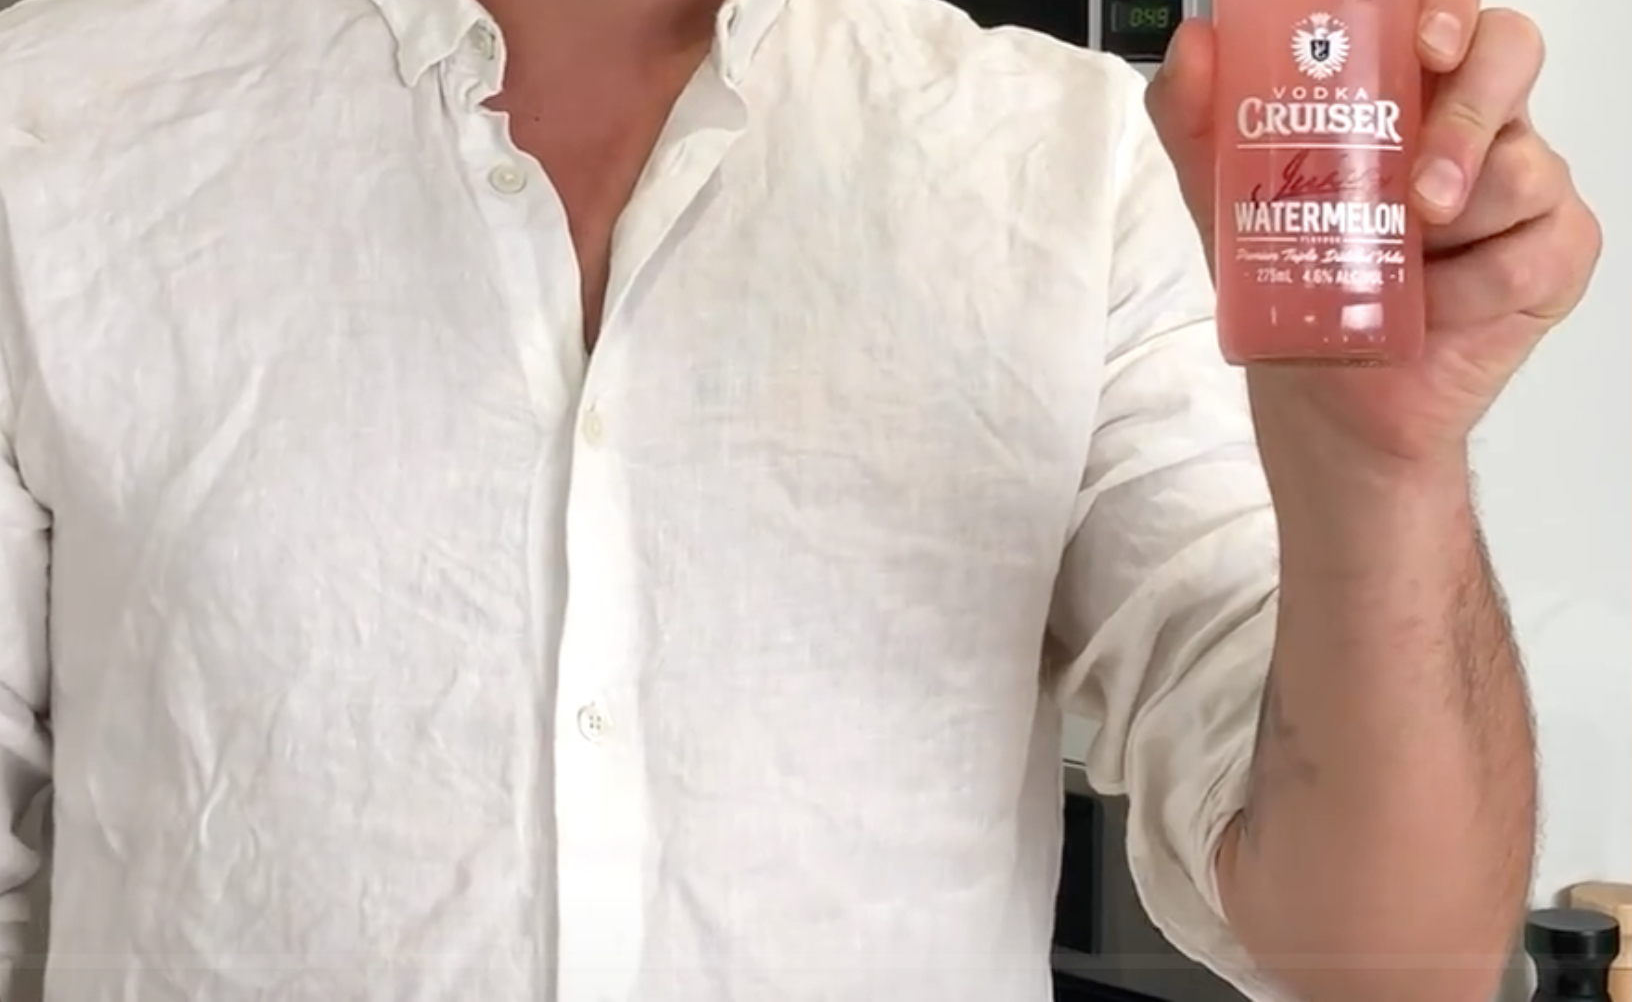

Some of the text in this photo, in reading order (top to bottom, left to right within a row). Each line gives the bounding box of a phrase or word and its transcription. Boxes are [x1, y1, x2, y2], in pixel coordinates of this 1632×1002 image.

[1272, 86, 1369, 100] VODKA
[1237, 97, 1403, 143] CRUISER
[1234, 201, 1406, 235] WATERMELON
